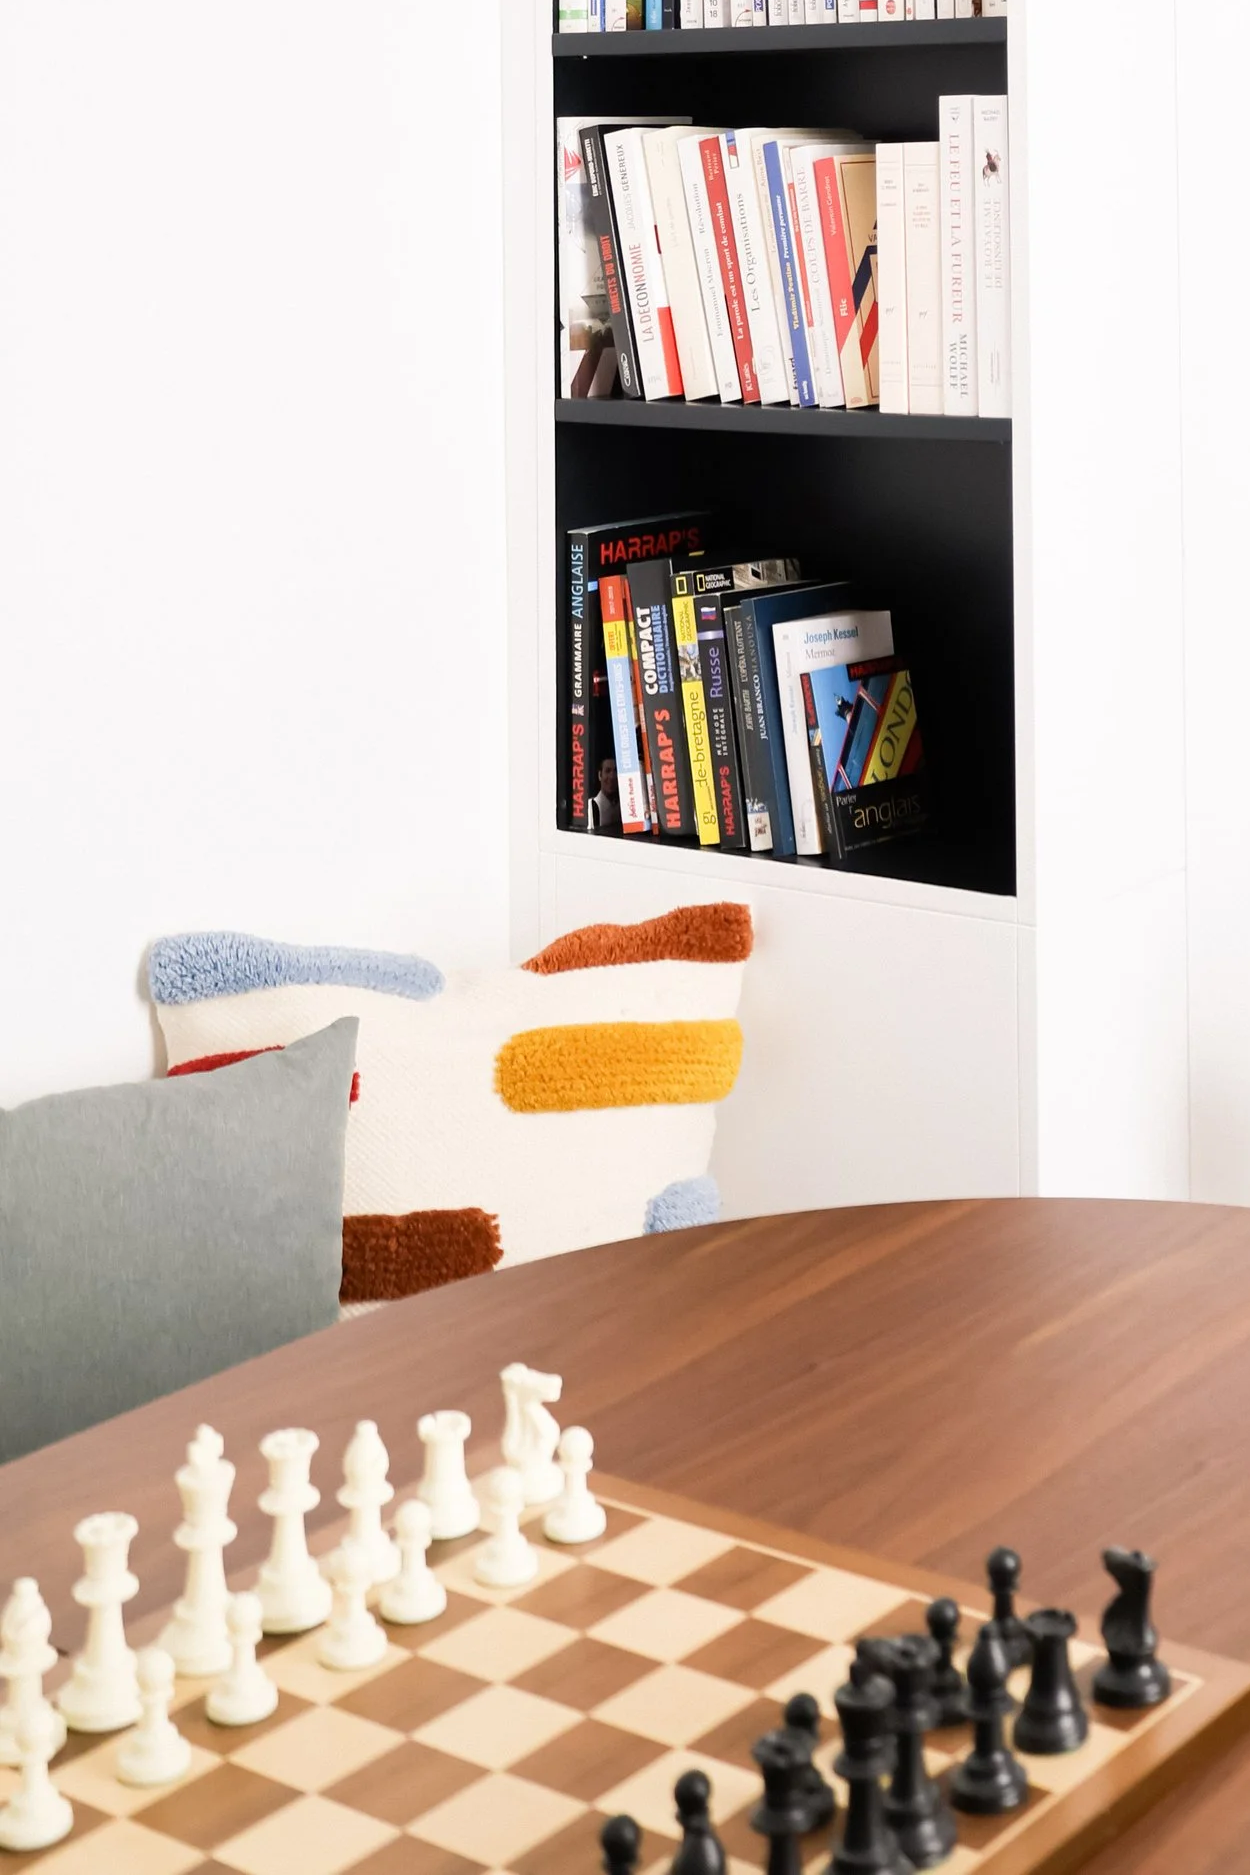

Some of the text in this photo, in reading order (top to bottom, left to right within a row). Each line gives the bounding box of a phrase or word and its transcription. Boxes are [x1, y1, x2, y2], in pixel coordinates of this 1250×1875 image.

[709, 0, 718, 7] 10
[709, 9, 718, 18] 18
[622, 193, 636, 230] JACQUES
[774, 195, 789, 259] Première personne
[796, 166, 821, 284] COUPS DE BARRE
[823, 176, 837, 236] Valentin Gendrot
[949, 134, 963, 323] LE FEU ET LA FUREUR
[606, 262, 616, 275] DU
[715, 202, 744, 341] La parole est un sport de combat
[736, 193, 761, 313] Les Organisations
[608, 277, 621, 314] DIRECTS
[702, 248, 724, 337] Emmanuel Macron
[785, 262, 800, 330] Vladimir Poutine
[839, 298, 848, 317] Flic
[641, 326, 655, 343] LA
[949, 342, 958, 390] WOLFF
[959, 333, 968, 399] MICHAEL
[600, 529, 699, 566] HARRAP'S
[705, 573, 725, 581] NATIONAL
[705, 579, 731, 589] GEOGRAPHIC
[650, 604, 669, 694] DICTIONNAIRE
[678, 608, 686, 642] NATIONAL
[803, 626, 859, 645] Joseph Kessel
[636, 606, 654, 696] COMPACT
[708, 646, 724, 699] Russe
[571, 543, 585, 818] HARRAP'S GRAMMAIRE ANGLAISE
[753, 674, 765, 714] BRANCO
[757, 715, 768, 741] JUAN
[653, 709, 681, 829] HARRAP'S
[719, 765, 735, 837] HARRAP'S
